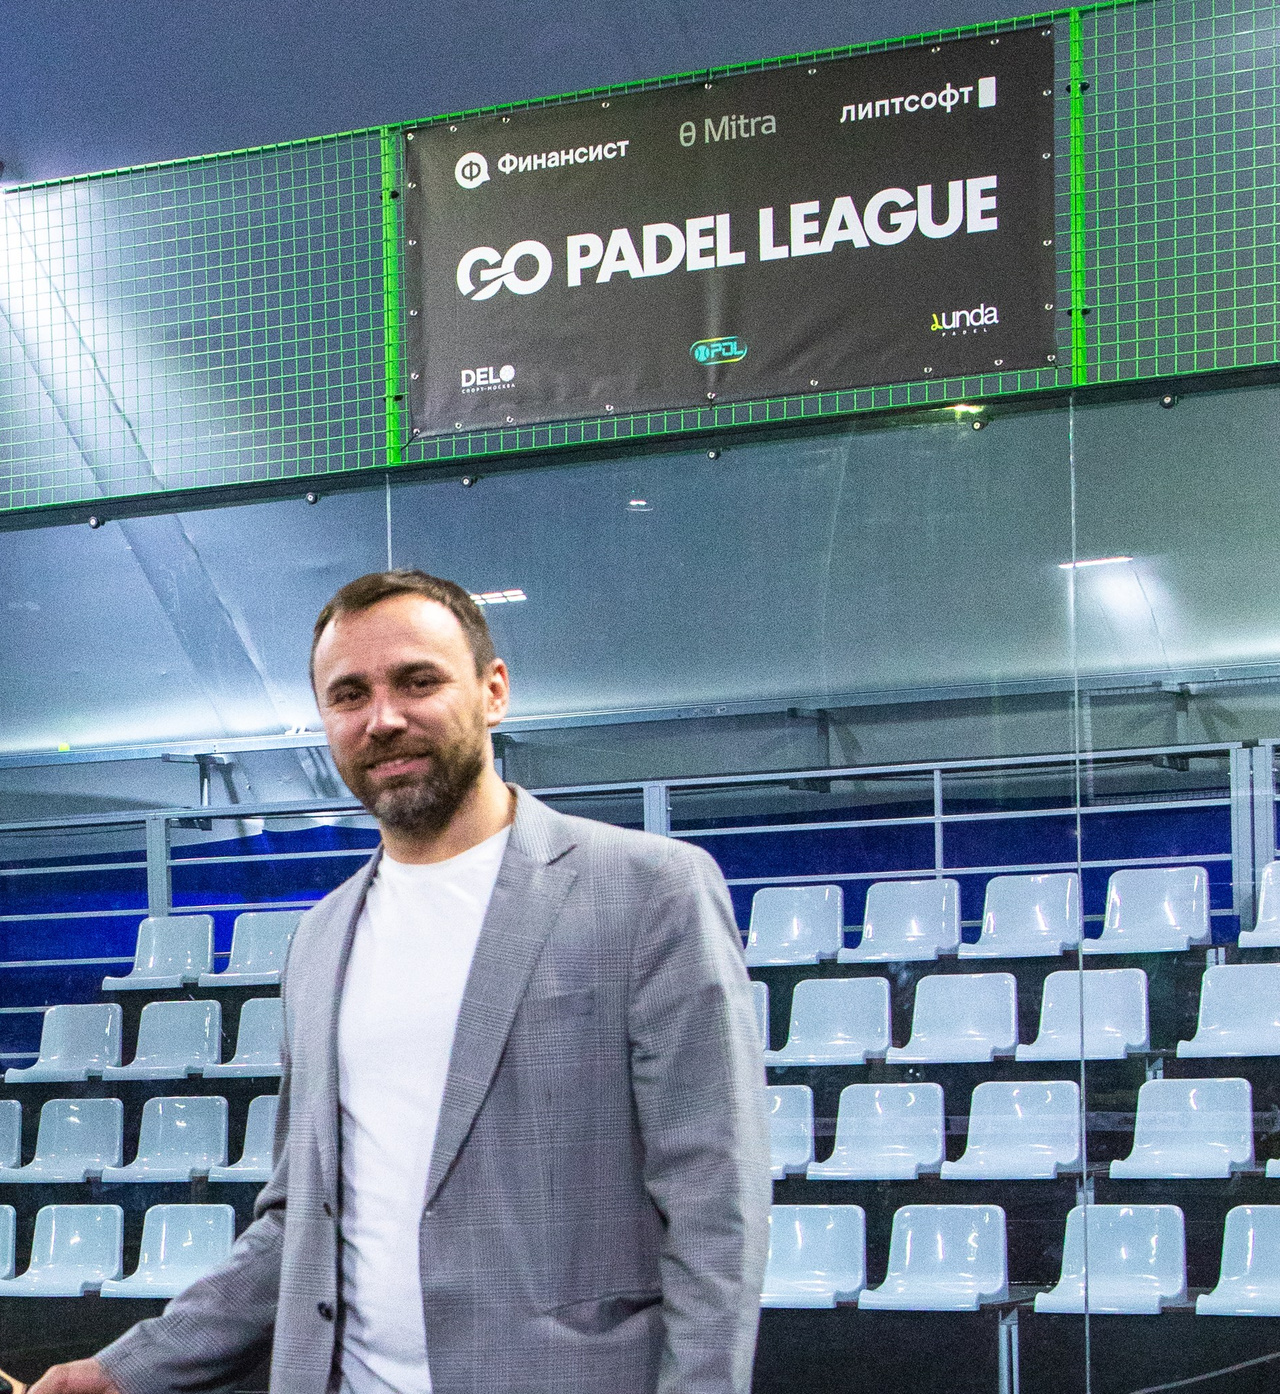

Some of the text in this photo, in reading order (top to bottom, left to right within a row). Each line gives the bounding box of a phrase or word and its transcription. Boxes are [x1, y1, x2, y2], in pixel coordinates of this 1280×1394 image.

[840, 82, 974, 124] липтсофт
[704, 114, 777, 144] Mitra
[497, 140, 630, 175] Финансист
[456, 175, 999, 301] GO PADEL LEAGUE
